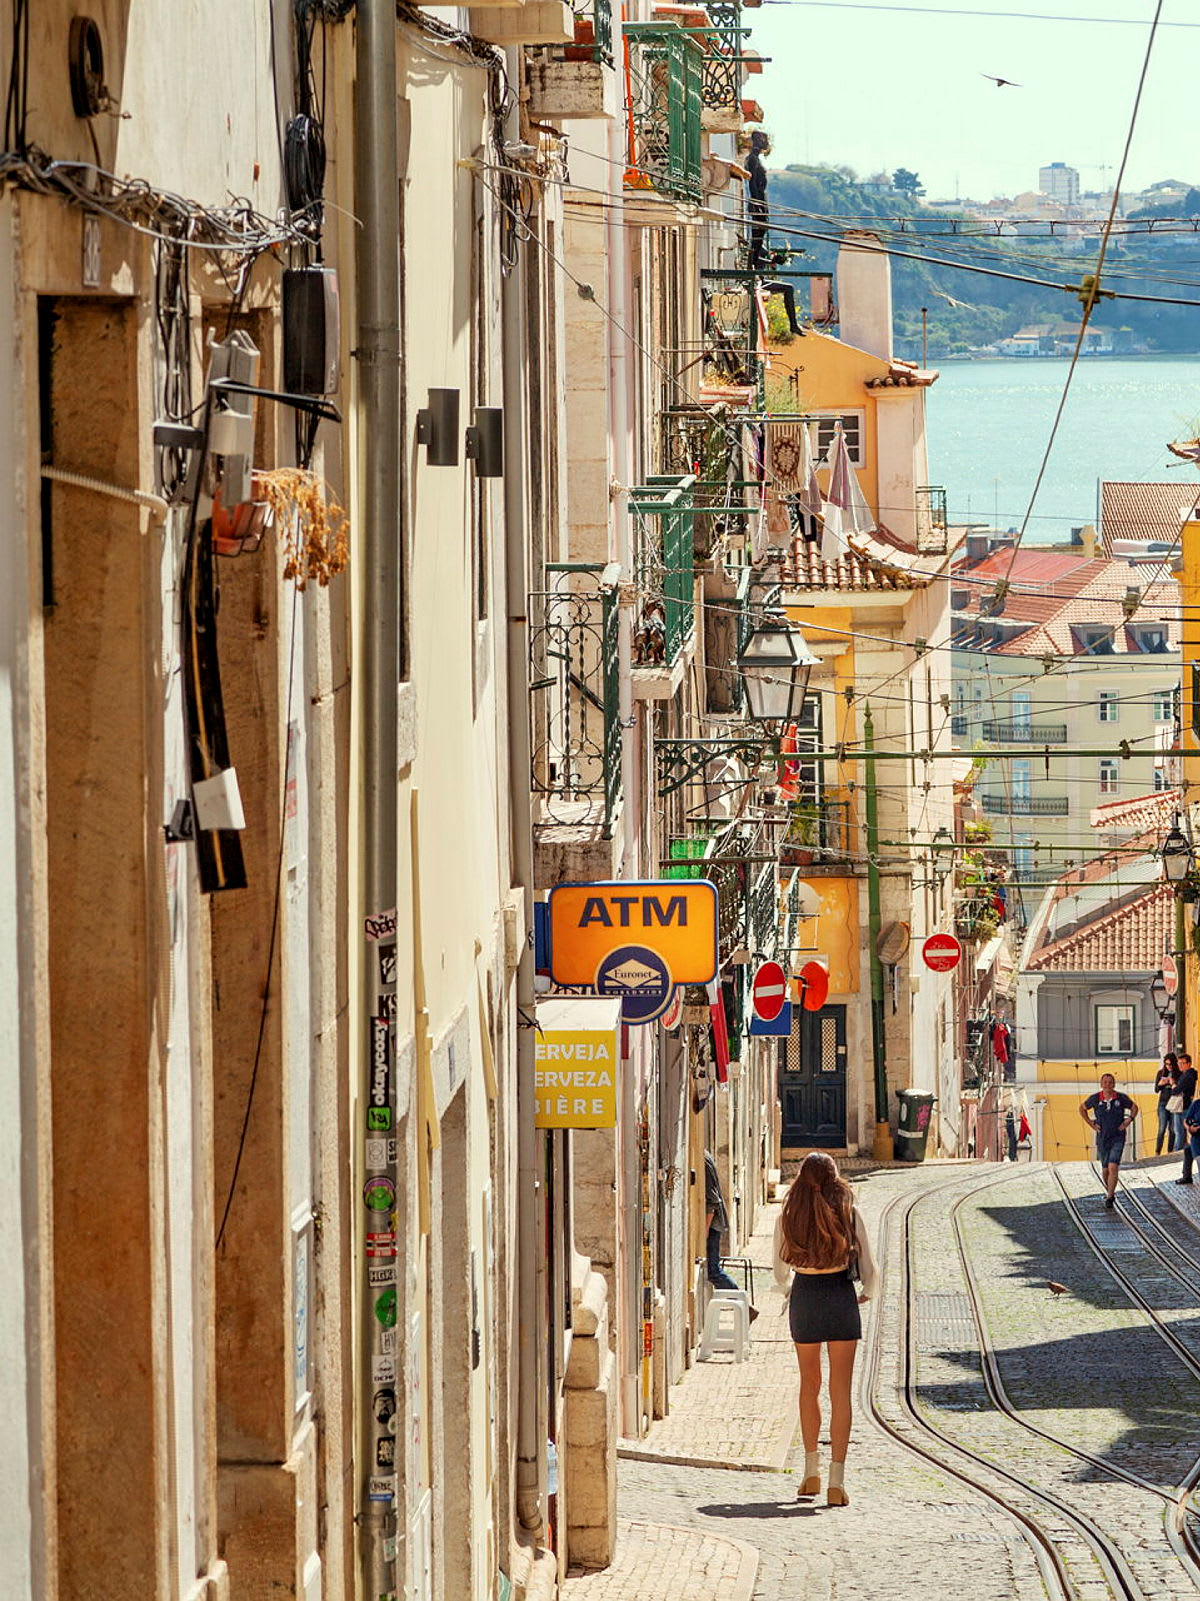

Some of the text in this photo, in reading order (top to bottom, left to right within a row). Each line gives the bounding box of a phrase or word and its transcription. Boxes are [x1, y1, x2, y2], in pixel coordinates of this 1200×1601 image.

[578, 896, 688, 928] ATM
[614, 969, 652, 979] Euronet
[535, 1044, 609, 1060] ERVEJA
[372, 1018, 388, 1106] okaycozy
[535, 1071, 611, 1087] ERVEZA
